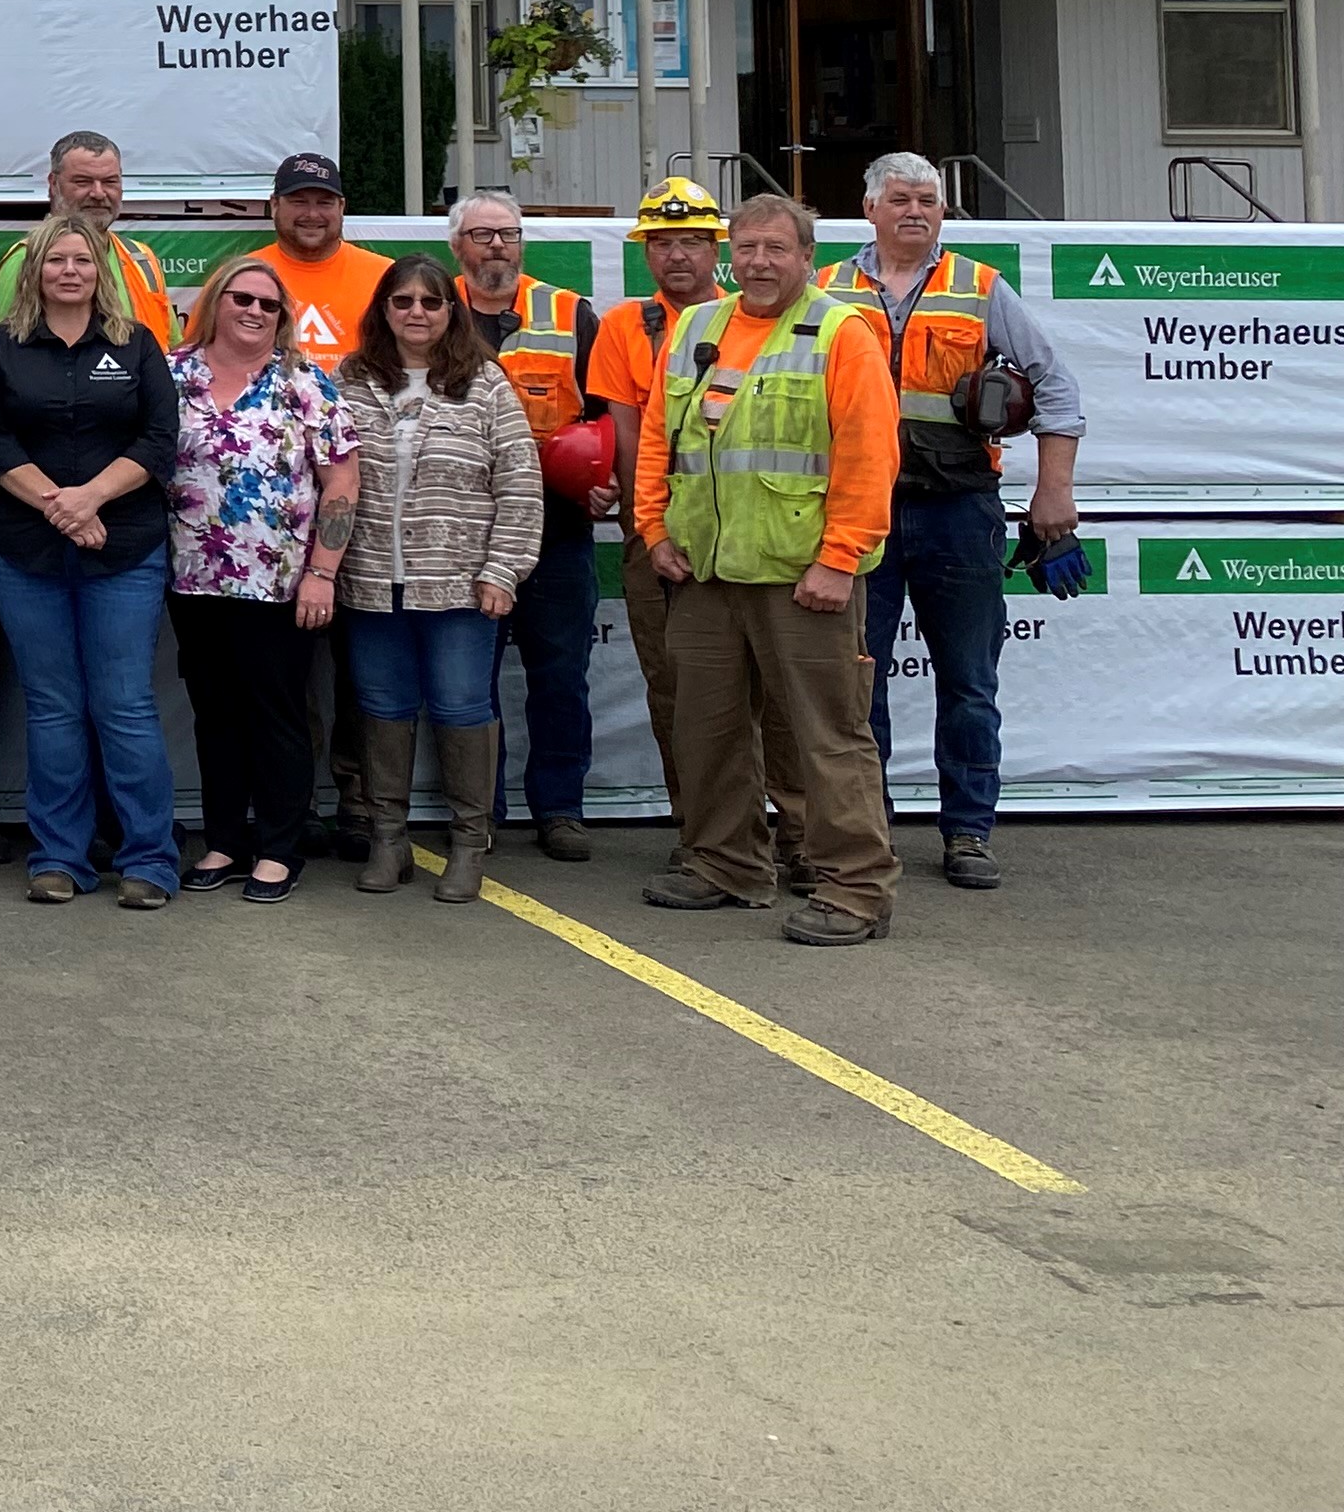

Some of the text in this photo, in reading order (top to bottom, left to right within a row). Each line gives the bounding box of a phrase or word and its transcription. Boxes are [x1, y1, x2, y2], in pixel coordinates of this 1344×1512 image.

[157, 41, 290, 69] Lumber
[1134, 265, 1281, 292] Weyerhaeuser
[1145, 353, 1273, 380] Lumber
